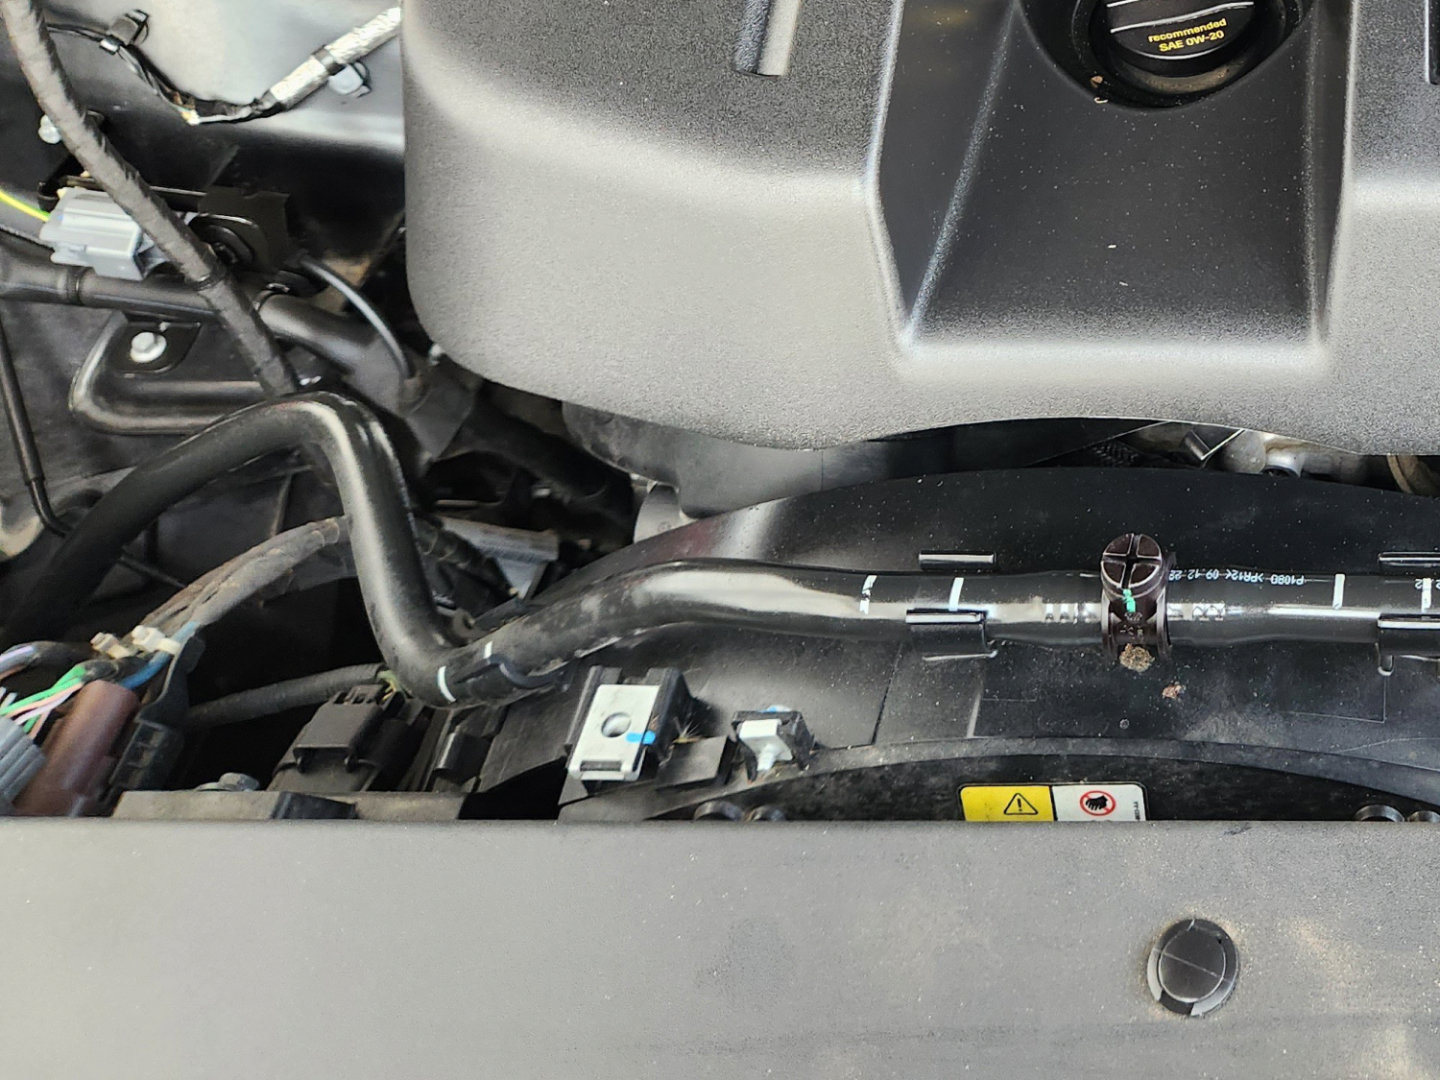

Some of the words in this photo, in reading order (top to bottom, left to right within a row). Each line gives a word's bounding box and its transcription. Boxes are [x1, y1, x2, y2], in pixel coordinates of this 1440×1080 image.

[1148, 18, 1227, 42] recommended
[1158, 40, 1184, 52] SAE
[1185, 30, 1225, 46] 0W-20
